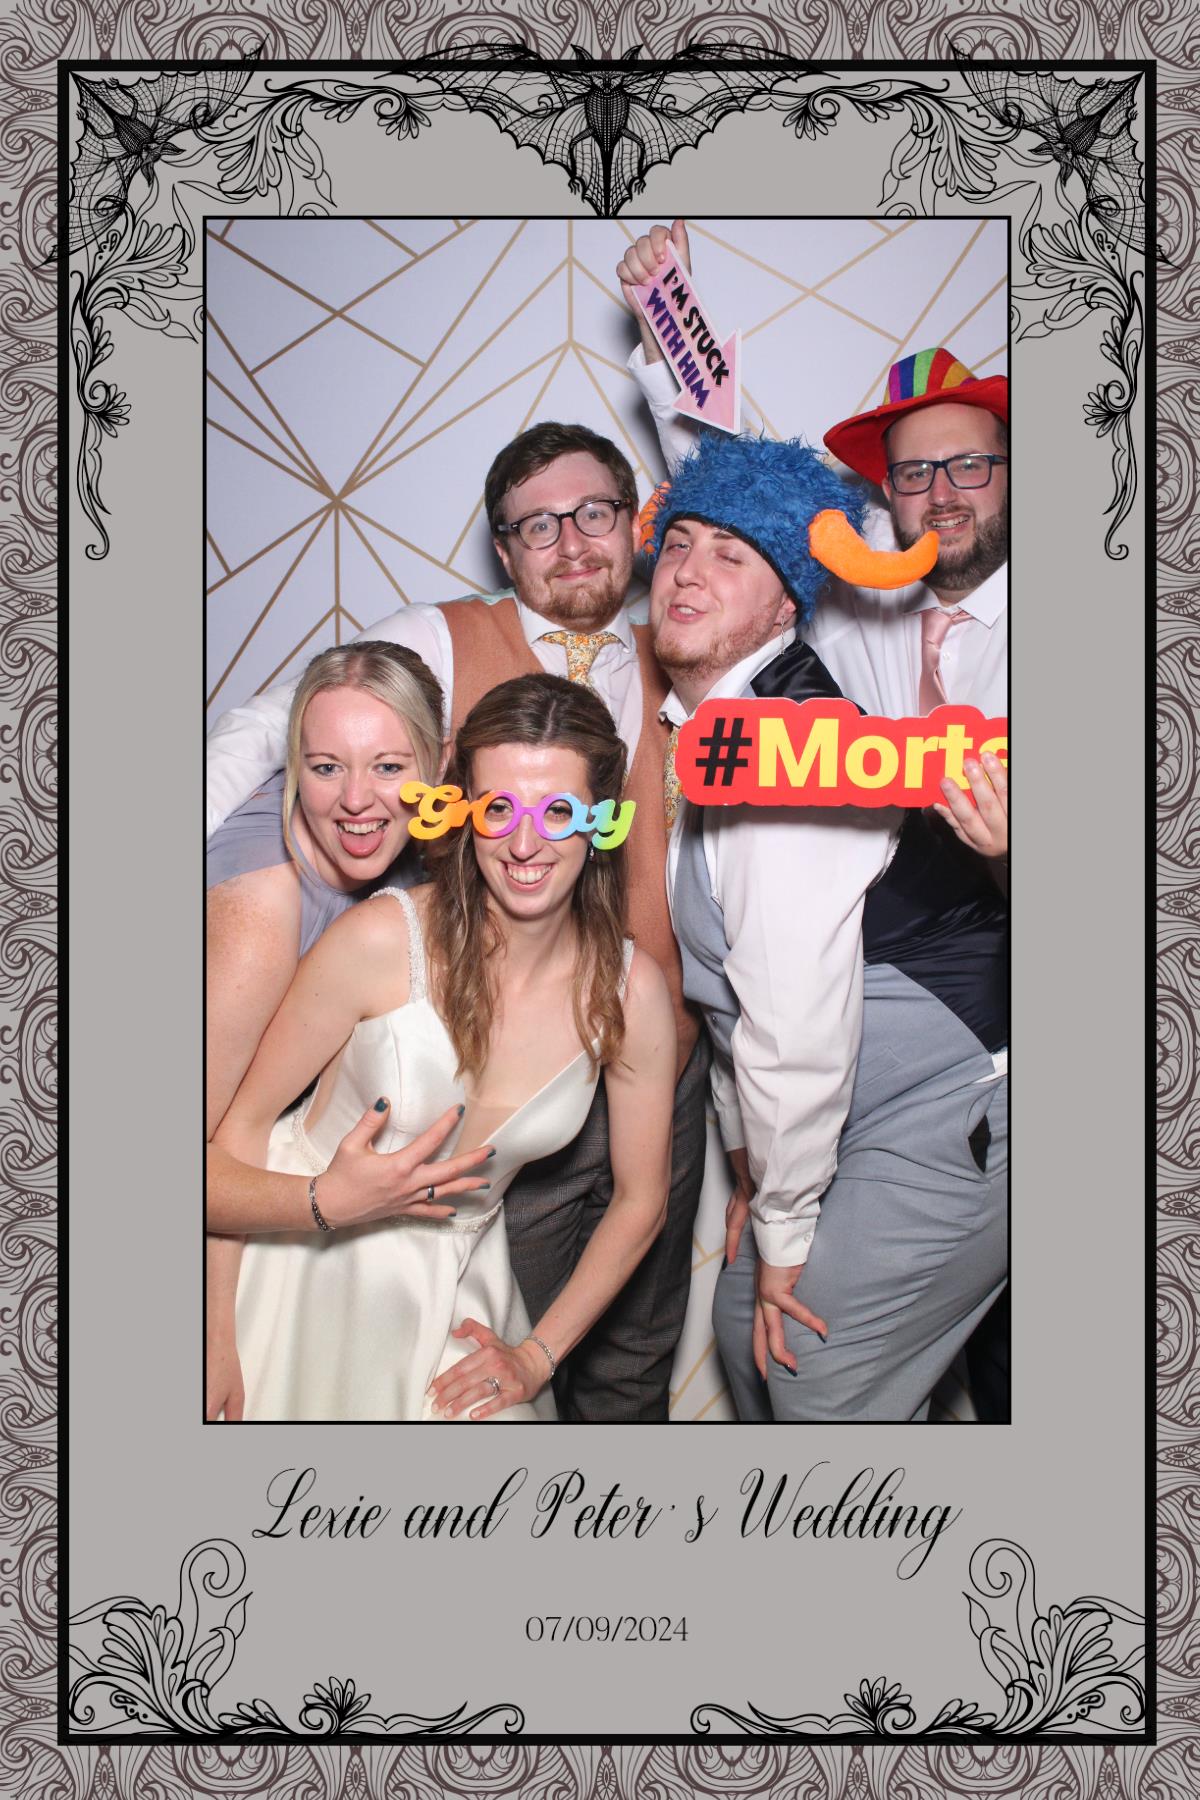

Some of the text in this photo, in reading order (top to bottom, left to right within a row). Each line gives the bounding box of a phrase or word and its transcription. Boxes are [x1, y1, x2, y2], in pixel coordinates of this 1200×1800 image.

[647, 287, 710, 409] WITH HIM
[663, 267, 729, 386] I'M STUCK
